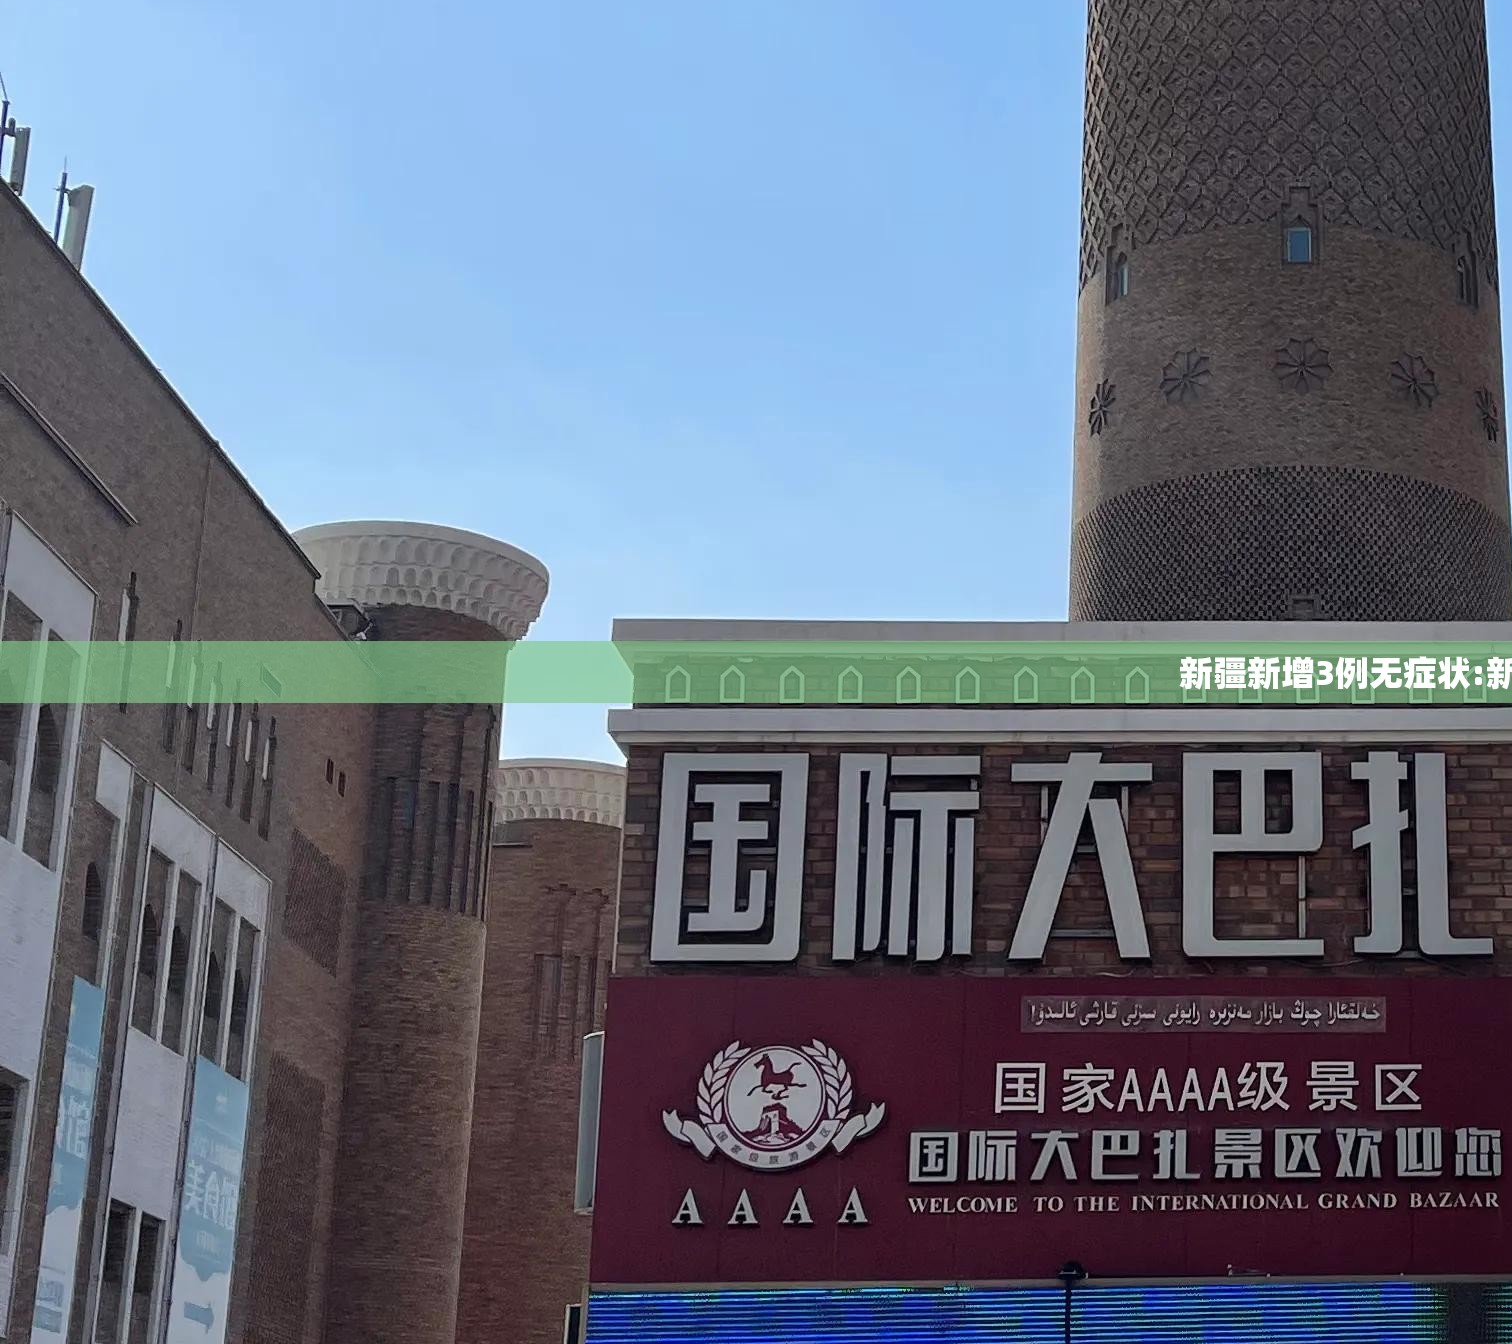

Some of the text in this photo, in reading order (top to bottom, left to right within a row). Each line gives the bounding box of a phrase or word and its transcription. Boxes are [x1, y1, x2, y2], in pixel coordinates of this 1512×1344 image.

[650, 751, 1495, 963] 国际大巴扎
[993, 1060, 1423, 1114] 国家AAAA级景区
[908, 1128, 1503, 1183] 国际大巴扎景区欢迎您
[908, 1191, 1500, 1214] WELCOME TO THE INTERNATIONAL GRAND BAZAAR
